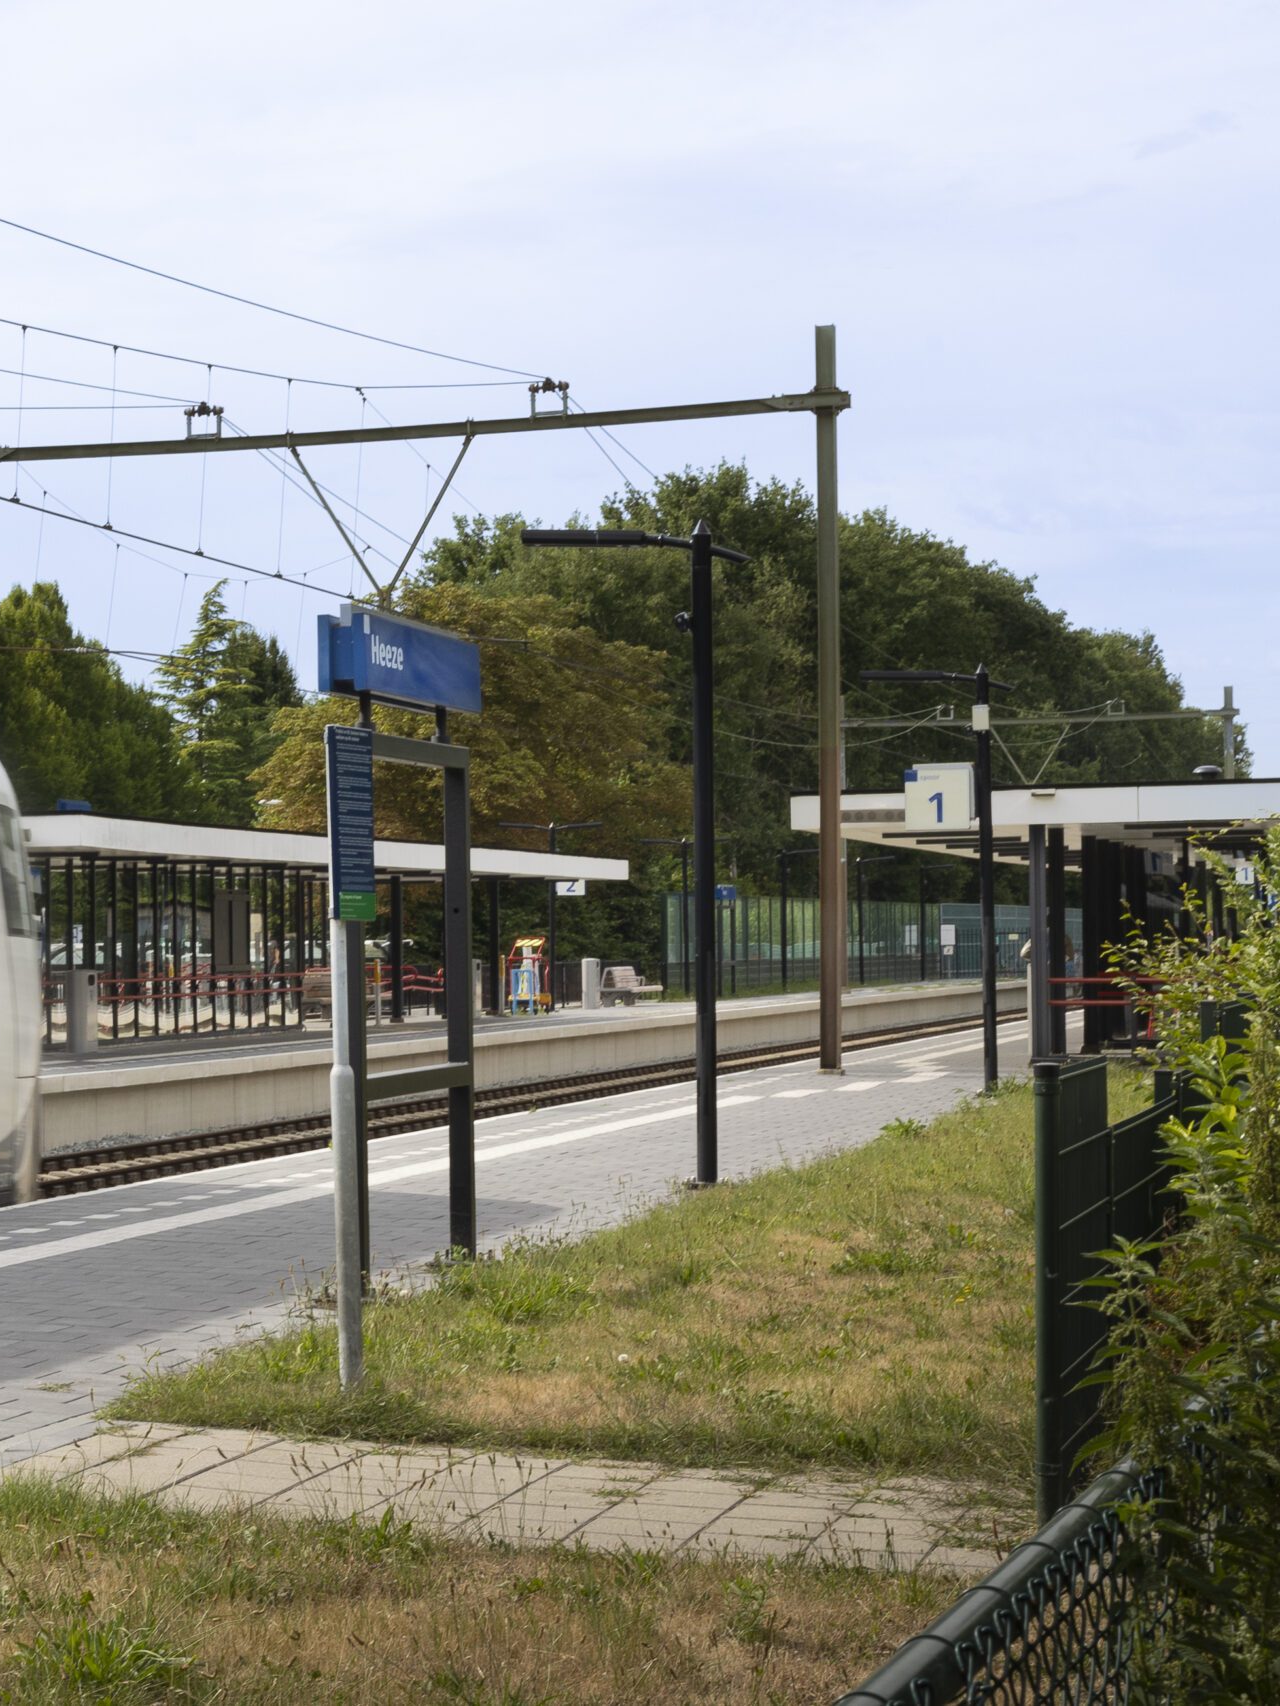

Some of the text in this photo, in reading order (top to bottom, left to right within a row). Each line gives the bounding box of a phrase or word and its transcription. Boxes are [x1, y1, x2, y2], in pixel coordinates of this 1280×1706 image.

[371, 634, 404, 671] Heeze
[928, 792, 943, 823] 1
[1240, 867, 1250, 881] 1
